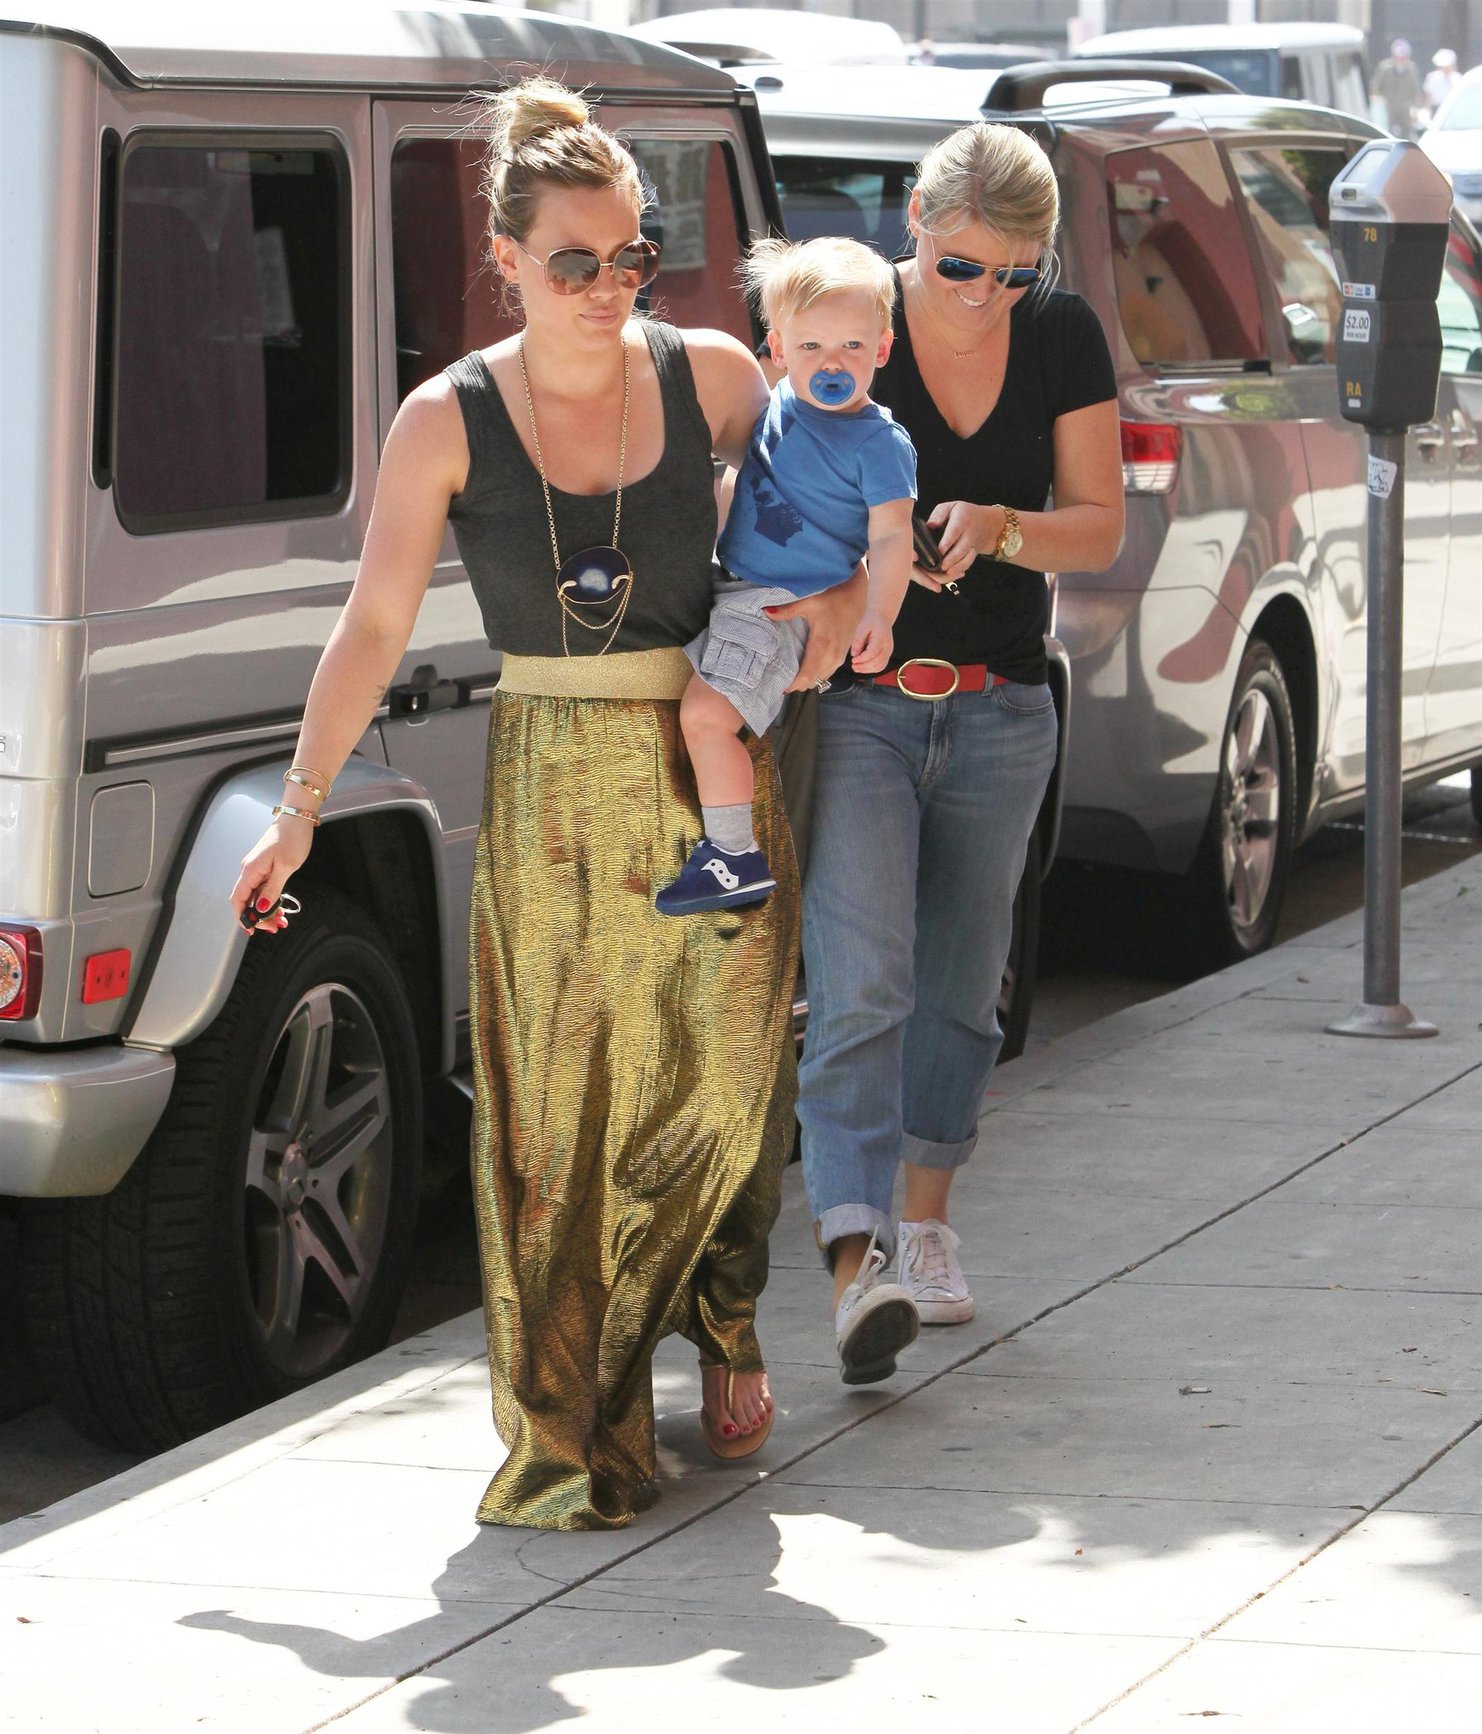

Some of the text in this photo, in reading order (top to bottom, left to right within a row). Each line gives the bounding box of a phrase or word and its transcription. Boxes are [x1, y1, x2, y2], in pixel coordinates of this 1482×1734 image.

[1363, 227, 1377, 241] 78
[1346, 314, 1369, 329] $2.00
[1346, 382, 1362, 397] RA
